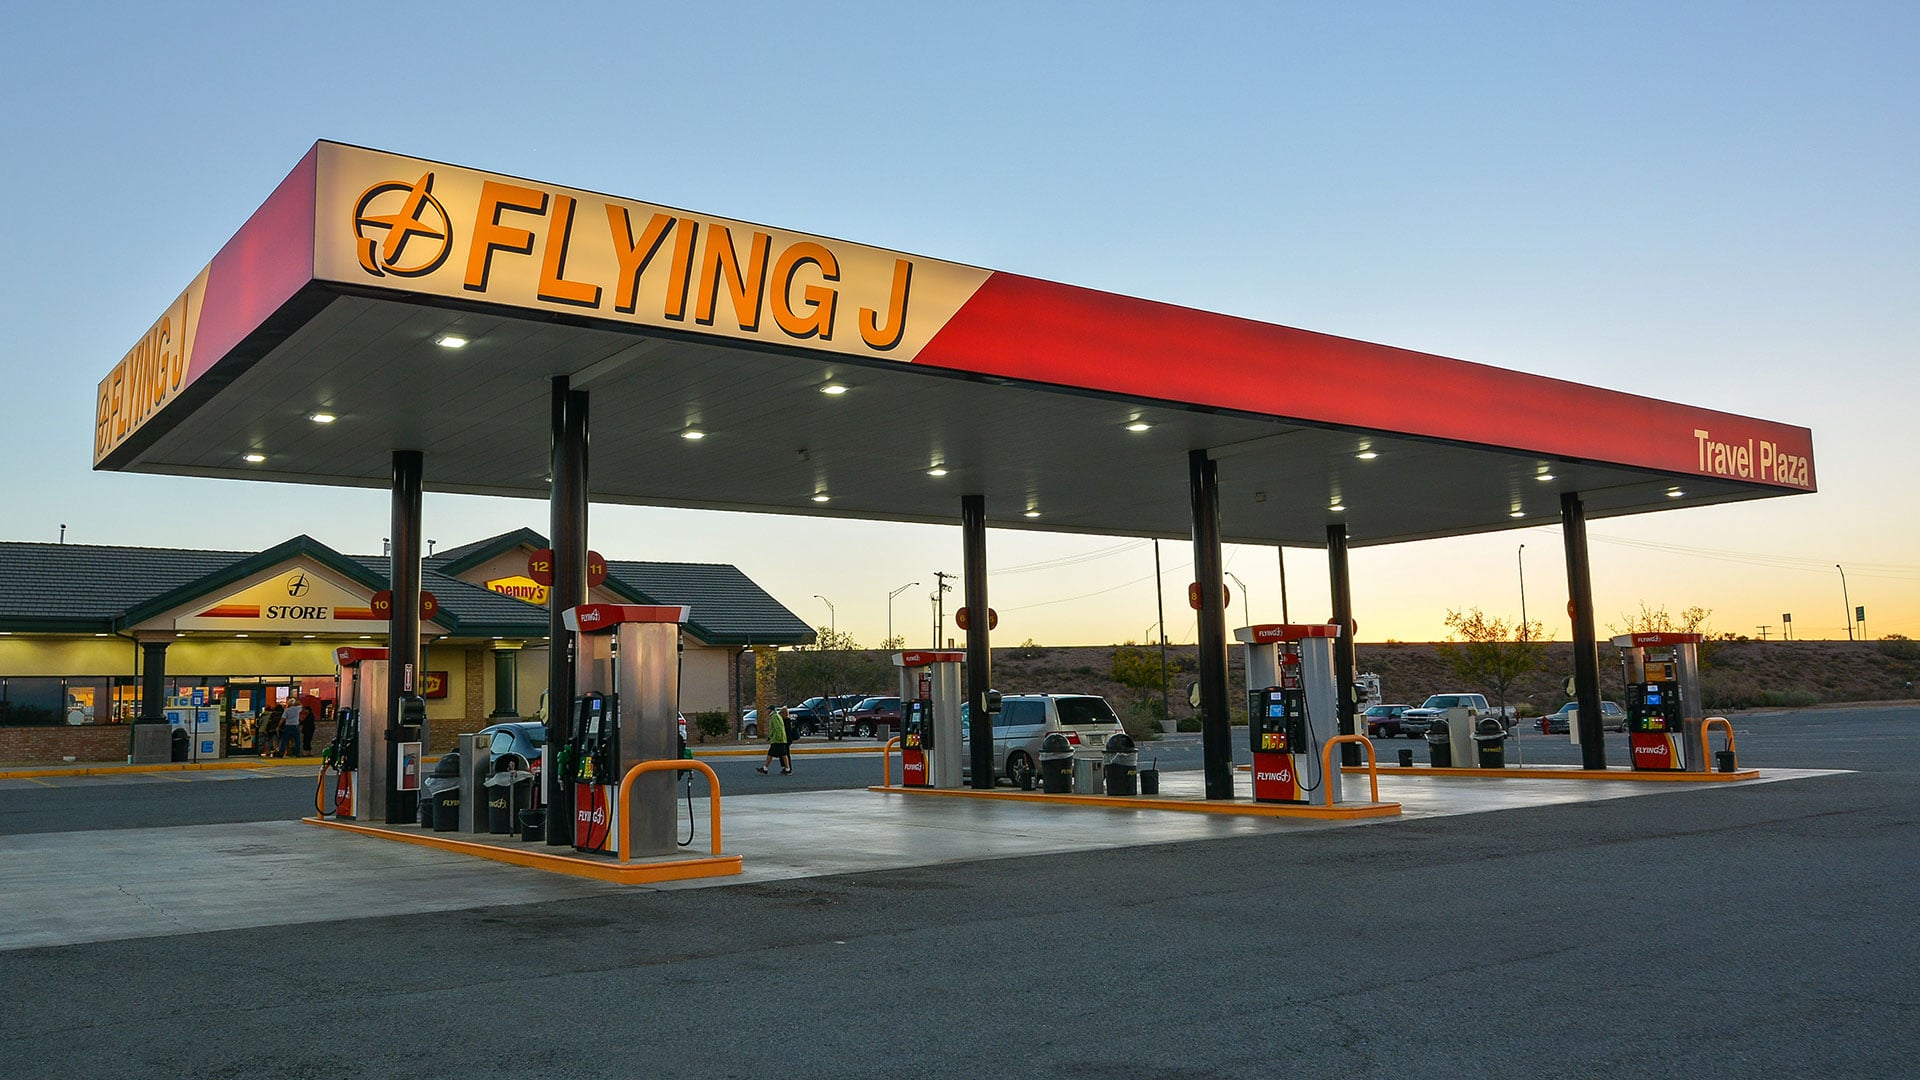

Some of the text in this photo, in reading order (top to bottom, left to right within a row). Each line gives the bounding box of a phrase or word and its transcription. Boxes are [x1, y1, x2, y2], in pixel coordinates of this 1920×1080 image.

[464, 180, 914, 351] FLYING J
[107, 292, 188, 450] FLYING J
[1694, 429, 1808, 486] Travel Plaza
[532, 561, 549, 572] 12
[590, 564, 602, 574] 11
[495, 585, 545, 600] Denny's
[1191, 592, 1198, 601] 8
[374, 601, 389, 610] 10
[424, 601, 432, 610] 9
[266, 606, 328, 620] STORE
[1257, 772, 1281, 781] FLYING
